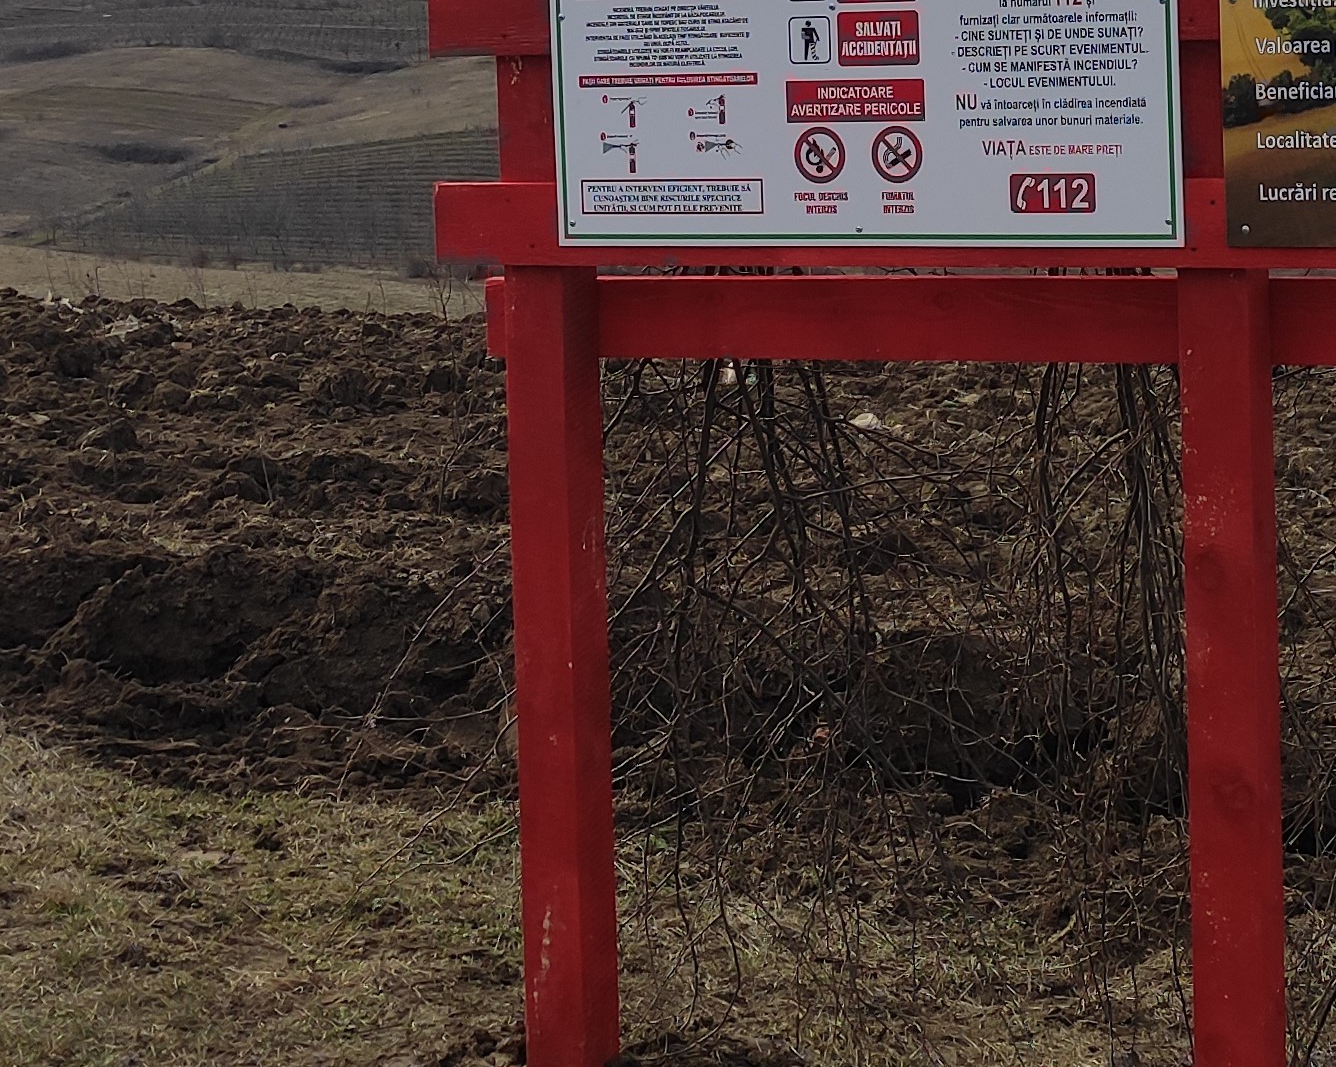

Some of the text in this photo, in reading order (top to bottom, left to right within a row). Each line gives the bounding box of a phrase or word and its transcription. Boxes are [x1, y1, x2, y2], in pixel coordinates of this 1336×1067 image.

[1002, 14, 1020, 24] clar
[856, 21, 900, 39] SALVAȚI
[961, 30, 984, 41] CINE
[1048, 29, 1061, 39] DE
[1065, 28, 1094, 39] UNDE
[1014, 46, 1027, 56] PE
[1031, 44, 1067, 55] SCURT
[1256, 37, 1330, 54] Valoarea
[968, 58, 1137, 73] CUM SE MANIFESTĂ INCENDIUL?
[990, 76, 1116, 88] LOCUL EVENIMENTULUI.
[818, 86, 893, 99] INDICATOARE
[791, 103, 921, 116] AVERTIZARE PERICOLE
[956, 94, 977, 110] NU
[960, 114, 1144, 129] pentru salvarea unor bunuri materiale.
[982, 140, 1093, 160] VIAȚA ESTE DE MARE
[1037, 179, 1089, 209] 112
[1259, 183, 1317, 201] Lucrări
